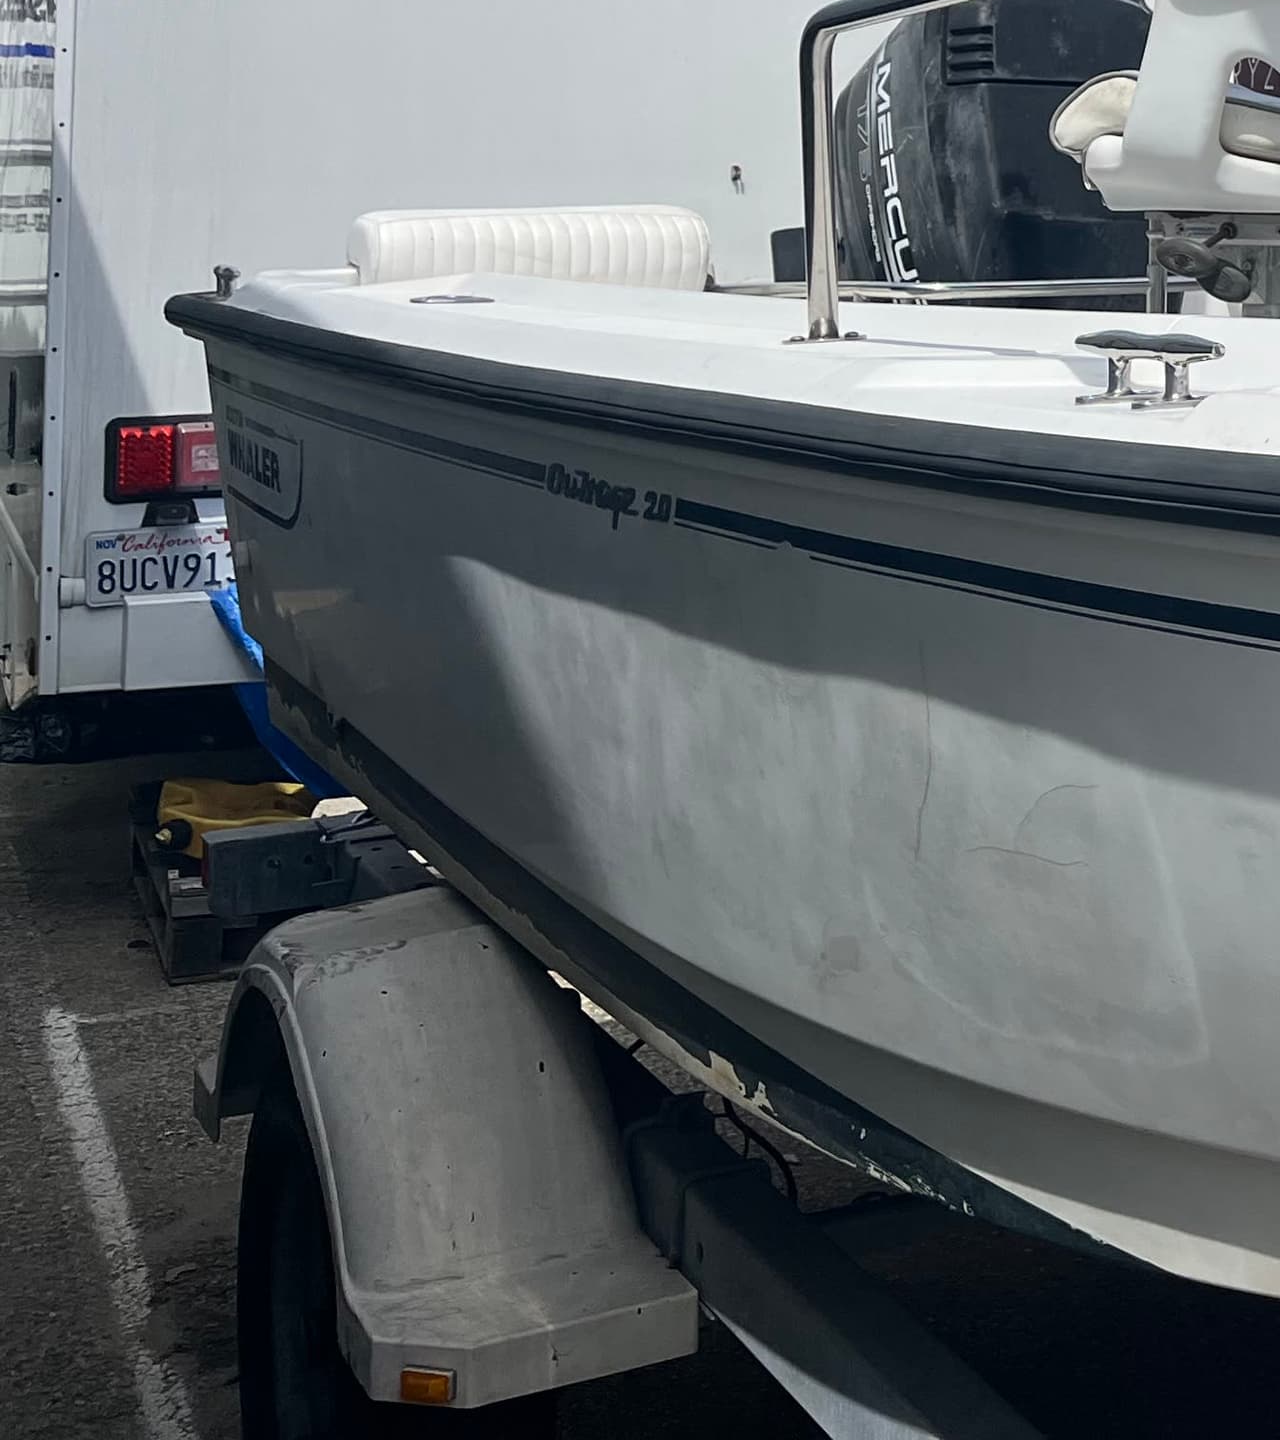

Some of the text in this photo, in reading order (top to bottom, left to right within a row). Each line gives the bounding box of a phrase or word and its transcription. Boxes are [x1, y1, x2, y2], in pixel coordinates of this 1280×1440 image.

[877, 62, 921, 284] MERCU
[227, 428, 281, 495] WHALER
[96, 532, 217, 555] NOV California
